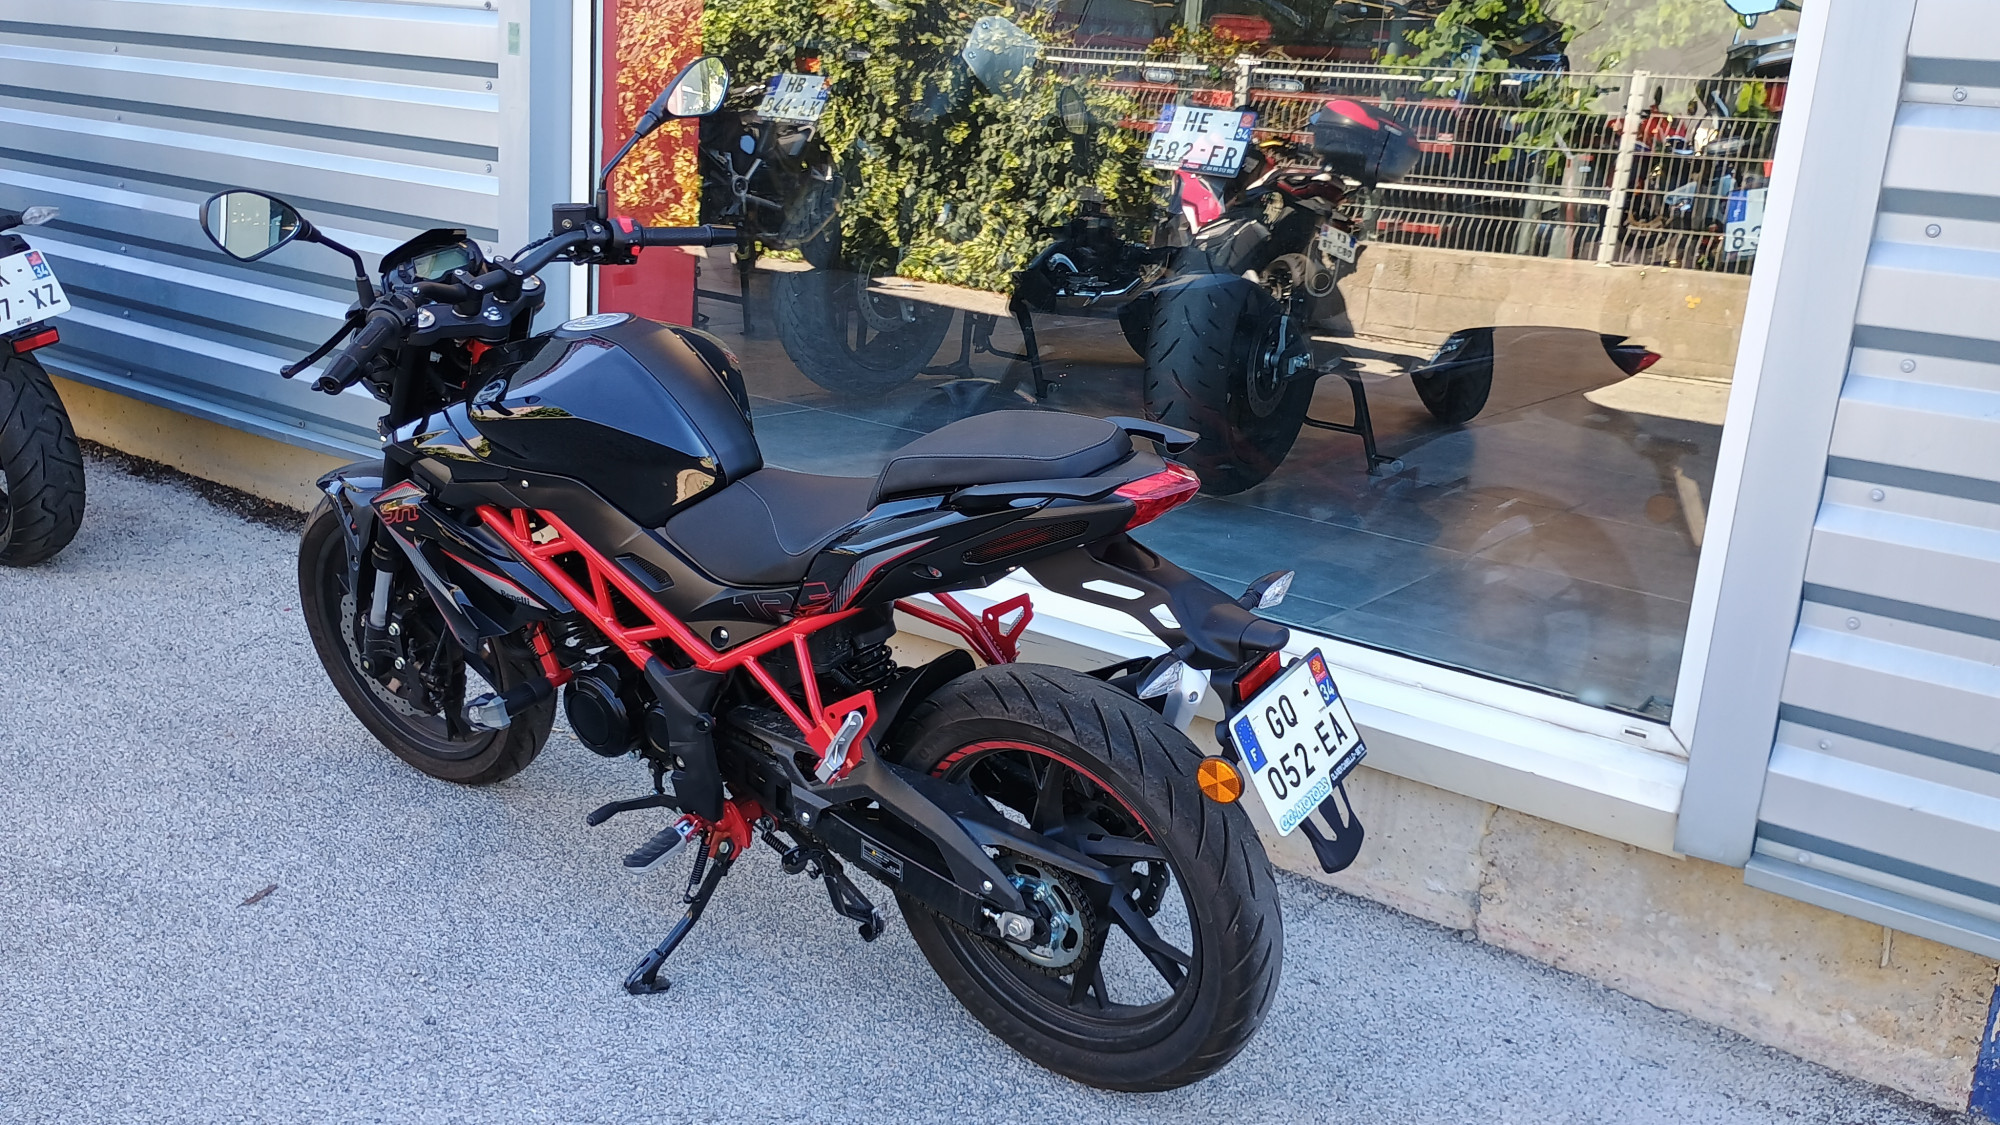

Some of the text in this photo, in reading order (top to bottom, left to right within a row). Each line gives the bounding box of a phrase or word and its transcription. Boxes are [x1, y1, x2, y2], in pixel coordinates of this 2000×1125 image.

[1183, 110, 1213, 133] HE
[1235, 128, 1249, 139] 34
[1151, 139, 1238, 168] 582-FR
[33, 263, 49, 278] 34
[500, 589, 530, 606] Benelli
[1319, 679, 1336, 701] 34
[1265, 694, 1299, 740] GQ
[1249, 747, 1260, 763] F
[1267, 711, 1349, 801] 052-EA
